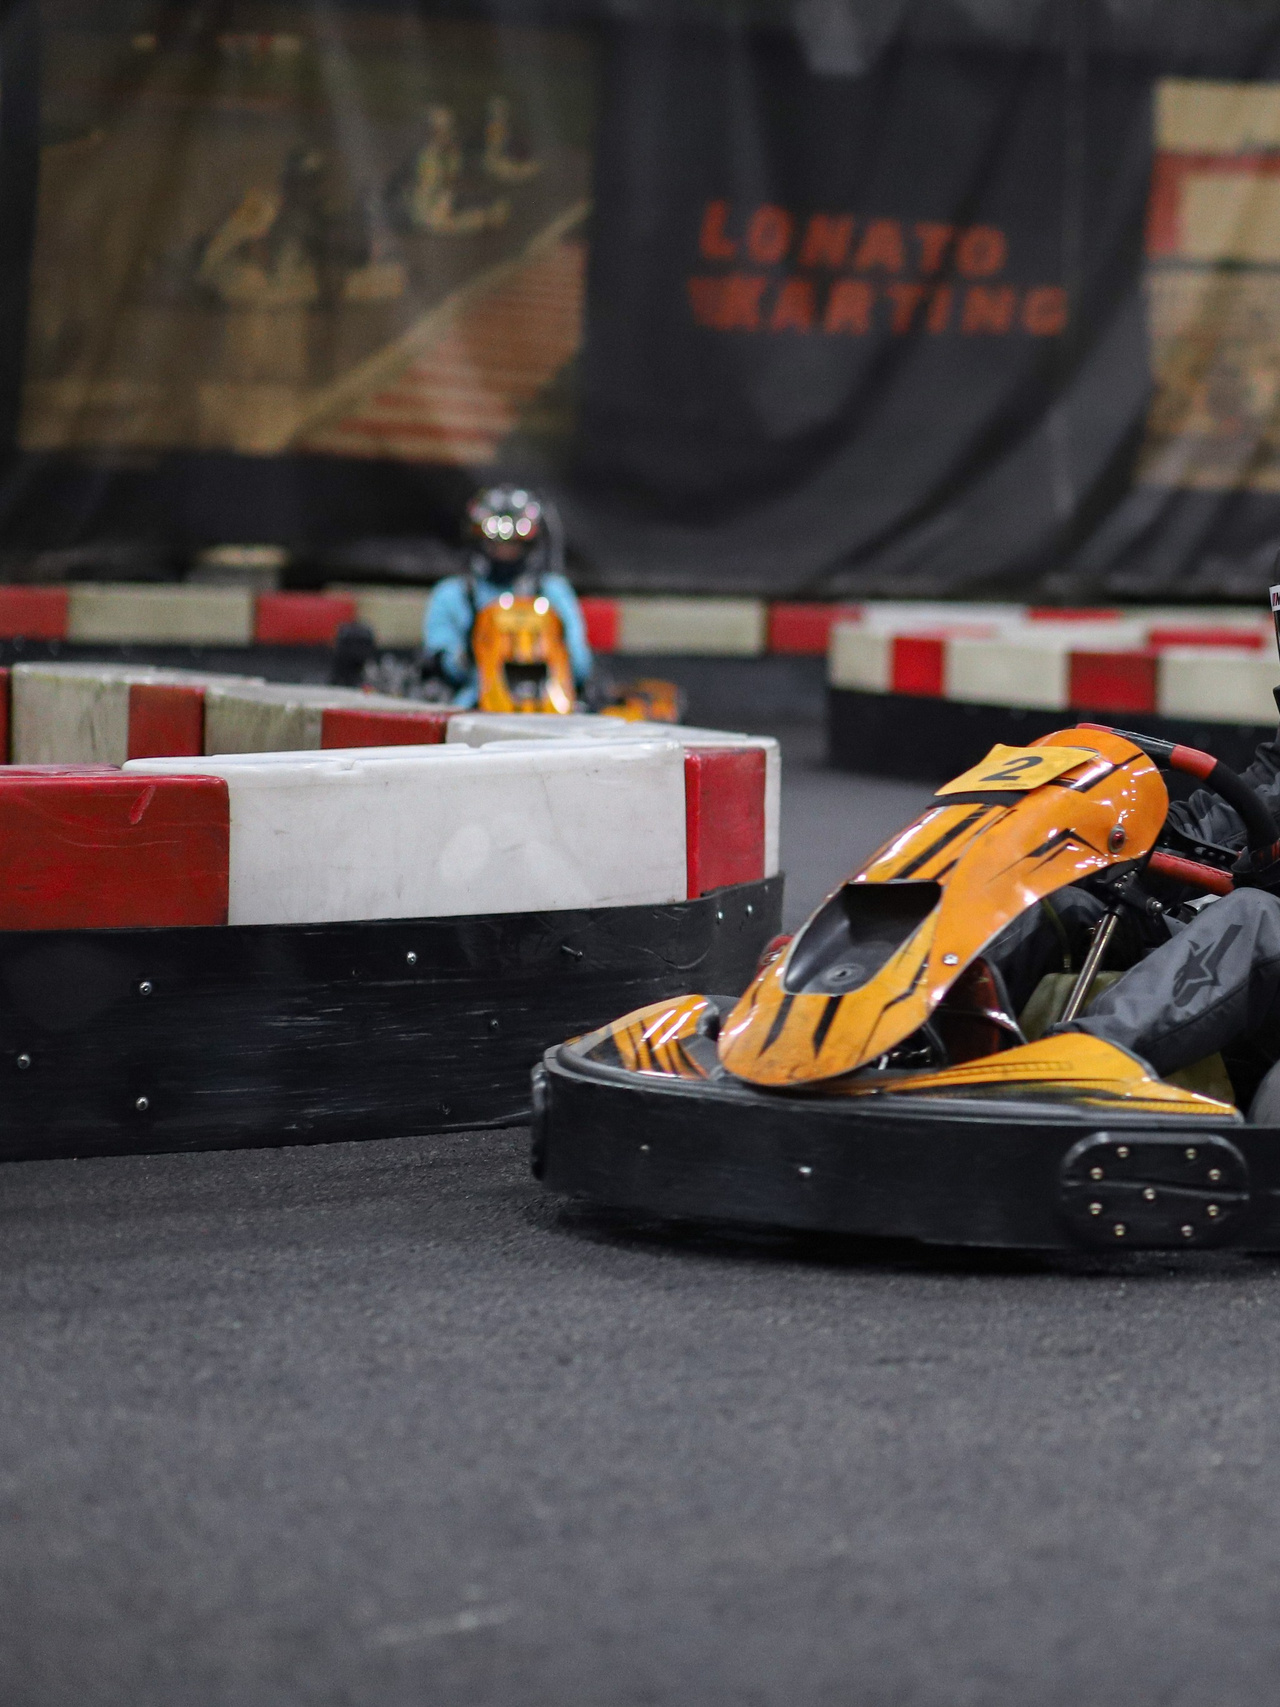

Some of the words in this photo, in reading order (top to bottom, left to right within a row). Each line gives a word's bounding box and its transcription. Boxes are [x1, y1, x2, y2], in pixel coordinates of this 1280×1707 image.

[701, 200, 1007, 278] LONATO
[688, 273, 1068, 335] KARTING
[979, 756, 1043, 781] 2
